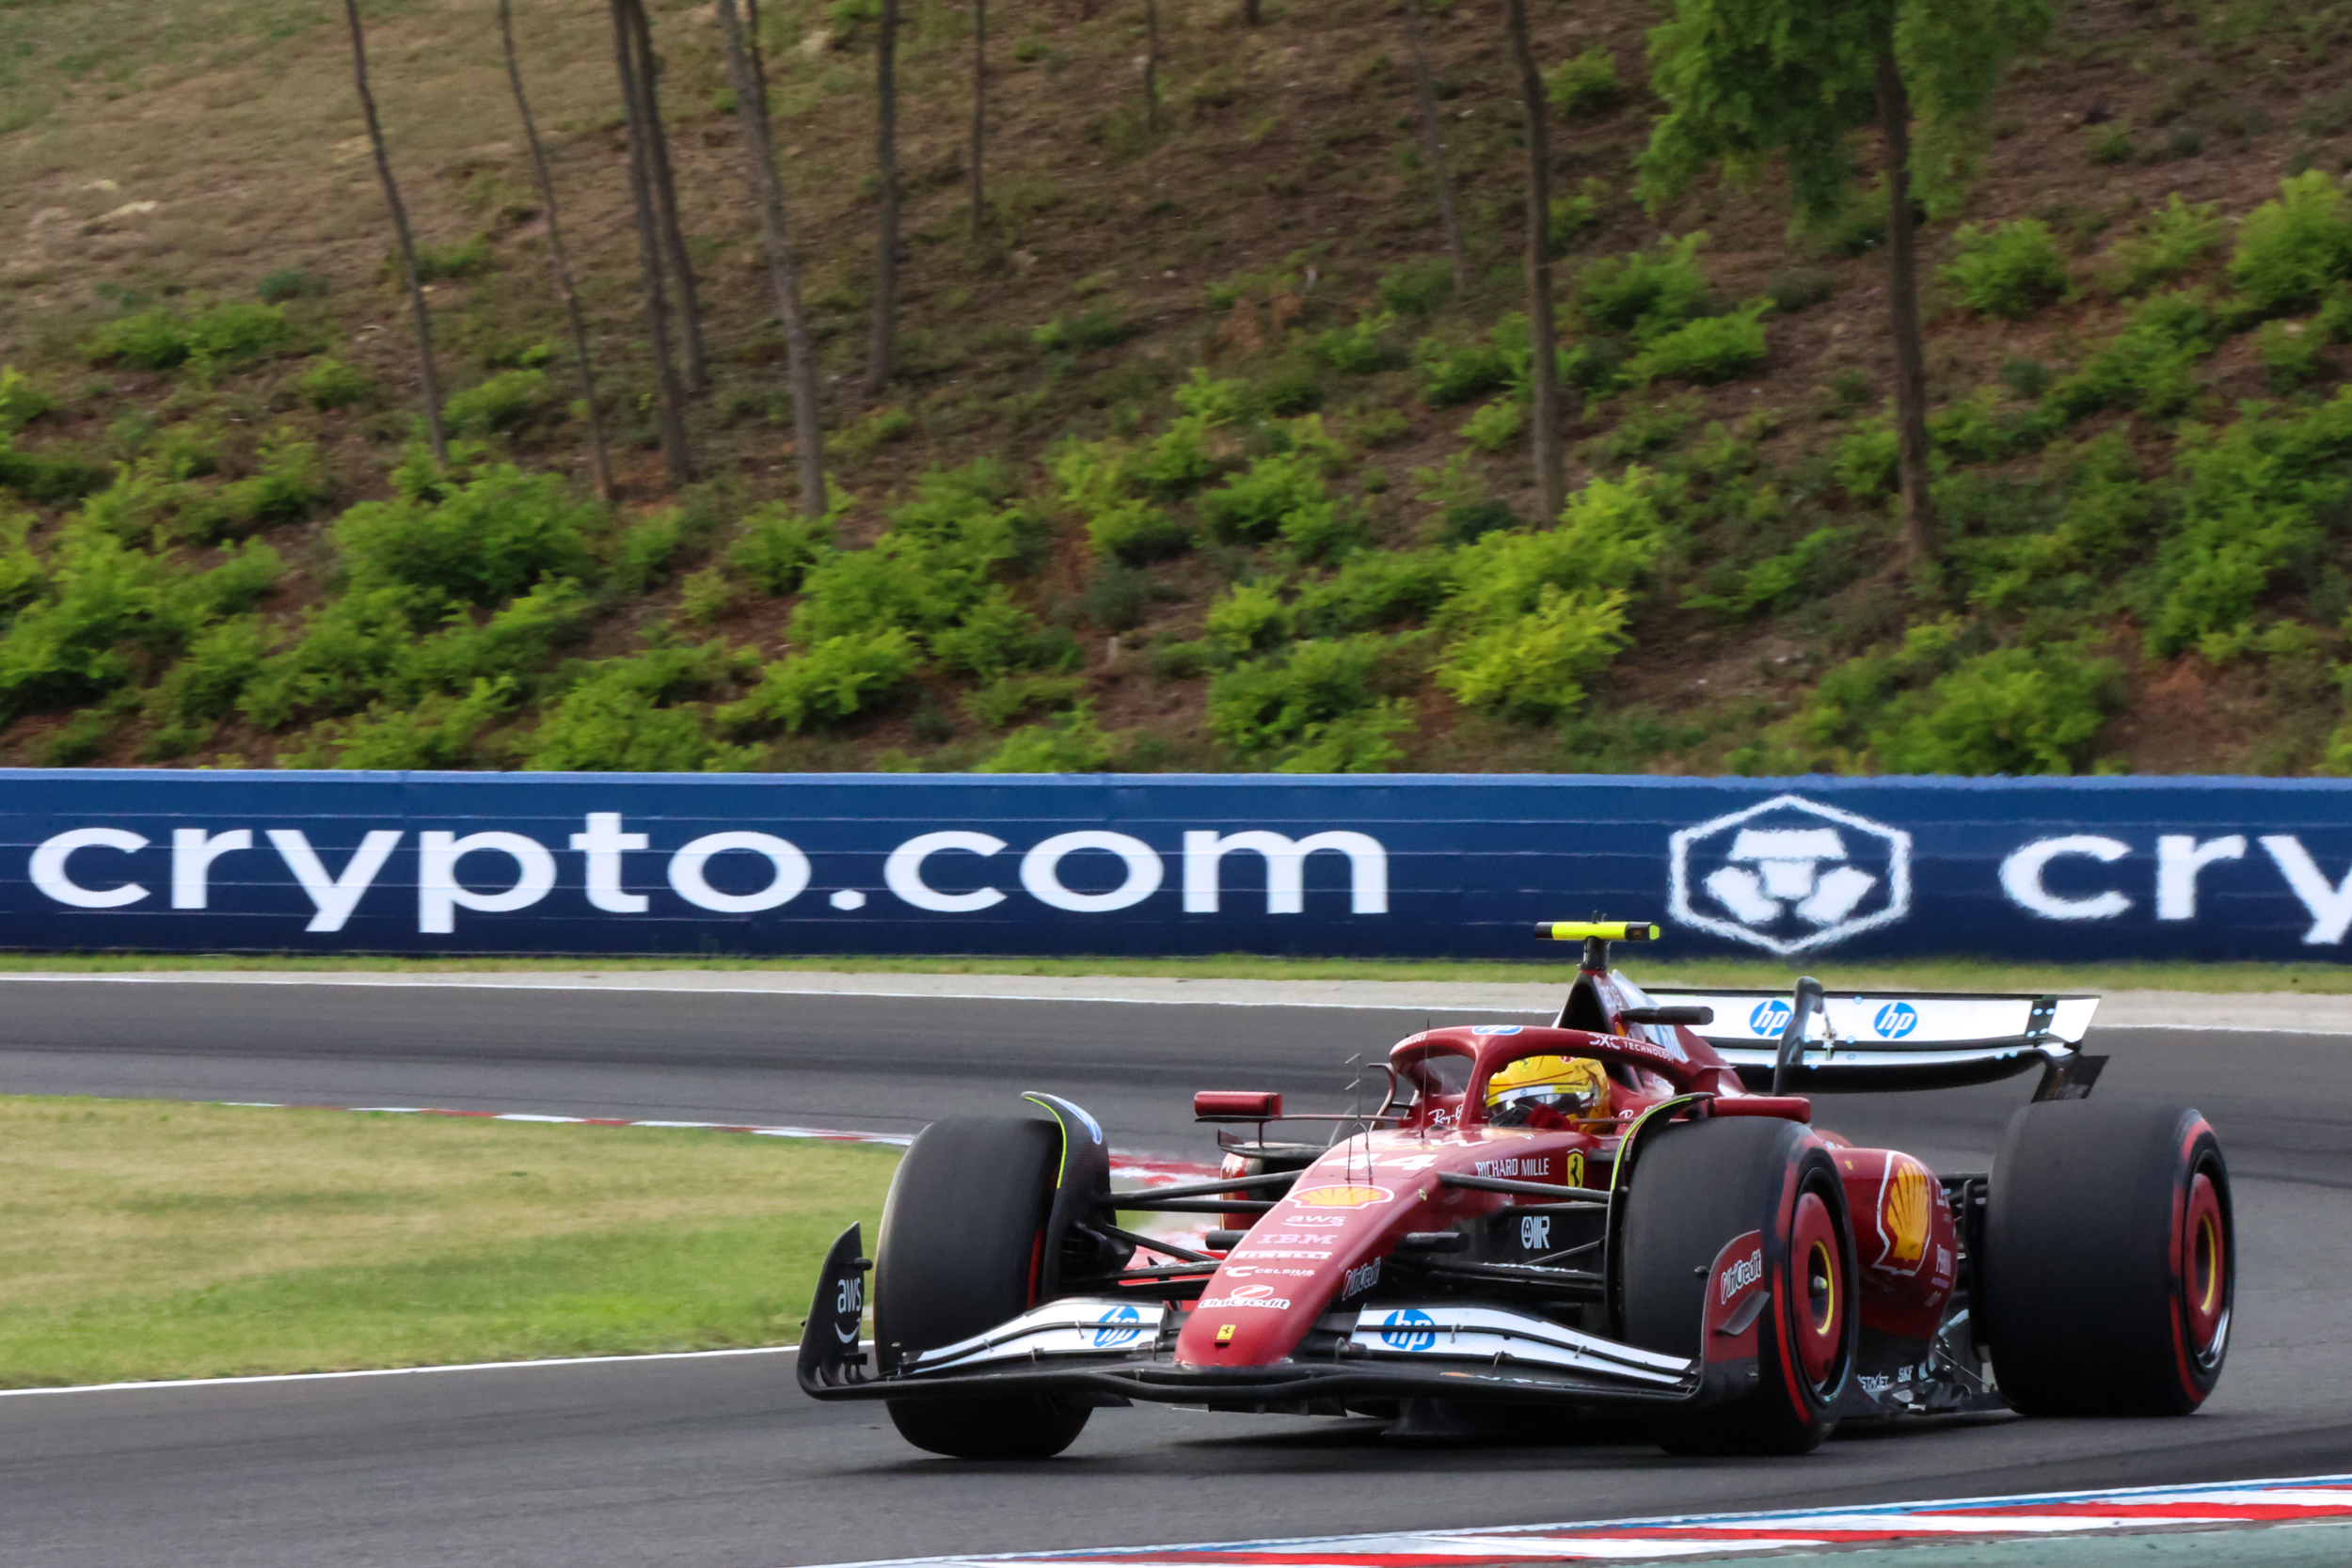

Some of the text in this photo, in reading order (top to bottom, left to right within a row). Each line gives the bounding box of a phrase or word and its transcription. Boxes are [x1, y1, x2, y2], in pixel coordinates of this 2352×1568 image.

[28, 812, 1389, 933] crypto.com
[1999, 834, 2352, 944] cry
[1752, 1000, 1792, 1037] hp
[1876, 1002, 1916, 1039] hp
[1587, 1033, 1675, 1063] DXC TECHNOLOGY
[1319, 1153, 1438, 1171] 44
[1475, 1158, 1549, 1177] RICHARD MILLE
[1233, 1250, 1333, 1259] PIRELLI
[1257, 1233, 1338, 1244] IBM
[836, 1277, 862, 1314] aws
[1199, 1298, 1291, 1309] UniCredit
[1095, 1306, 1138, 1348] hp
[1385, 1309, 1433, 1351] hp
[1898, 1365, 1914, 1383] SKF
